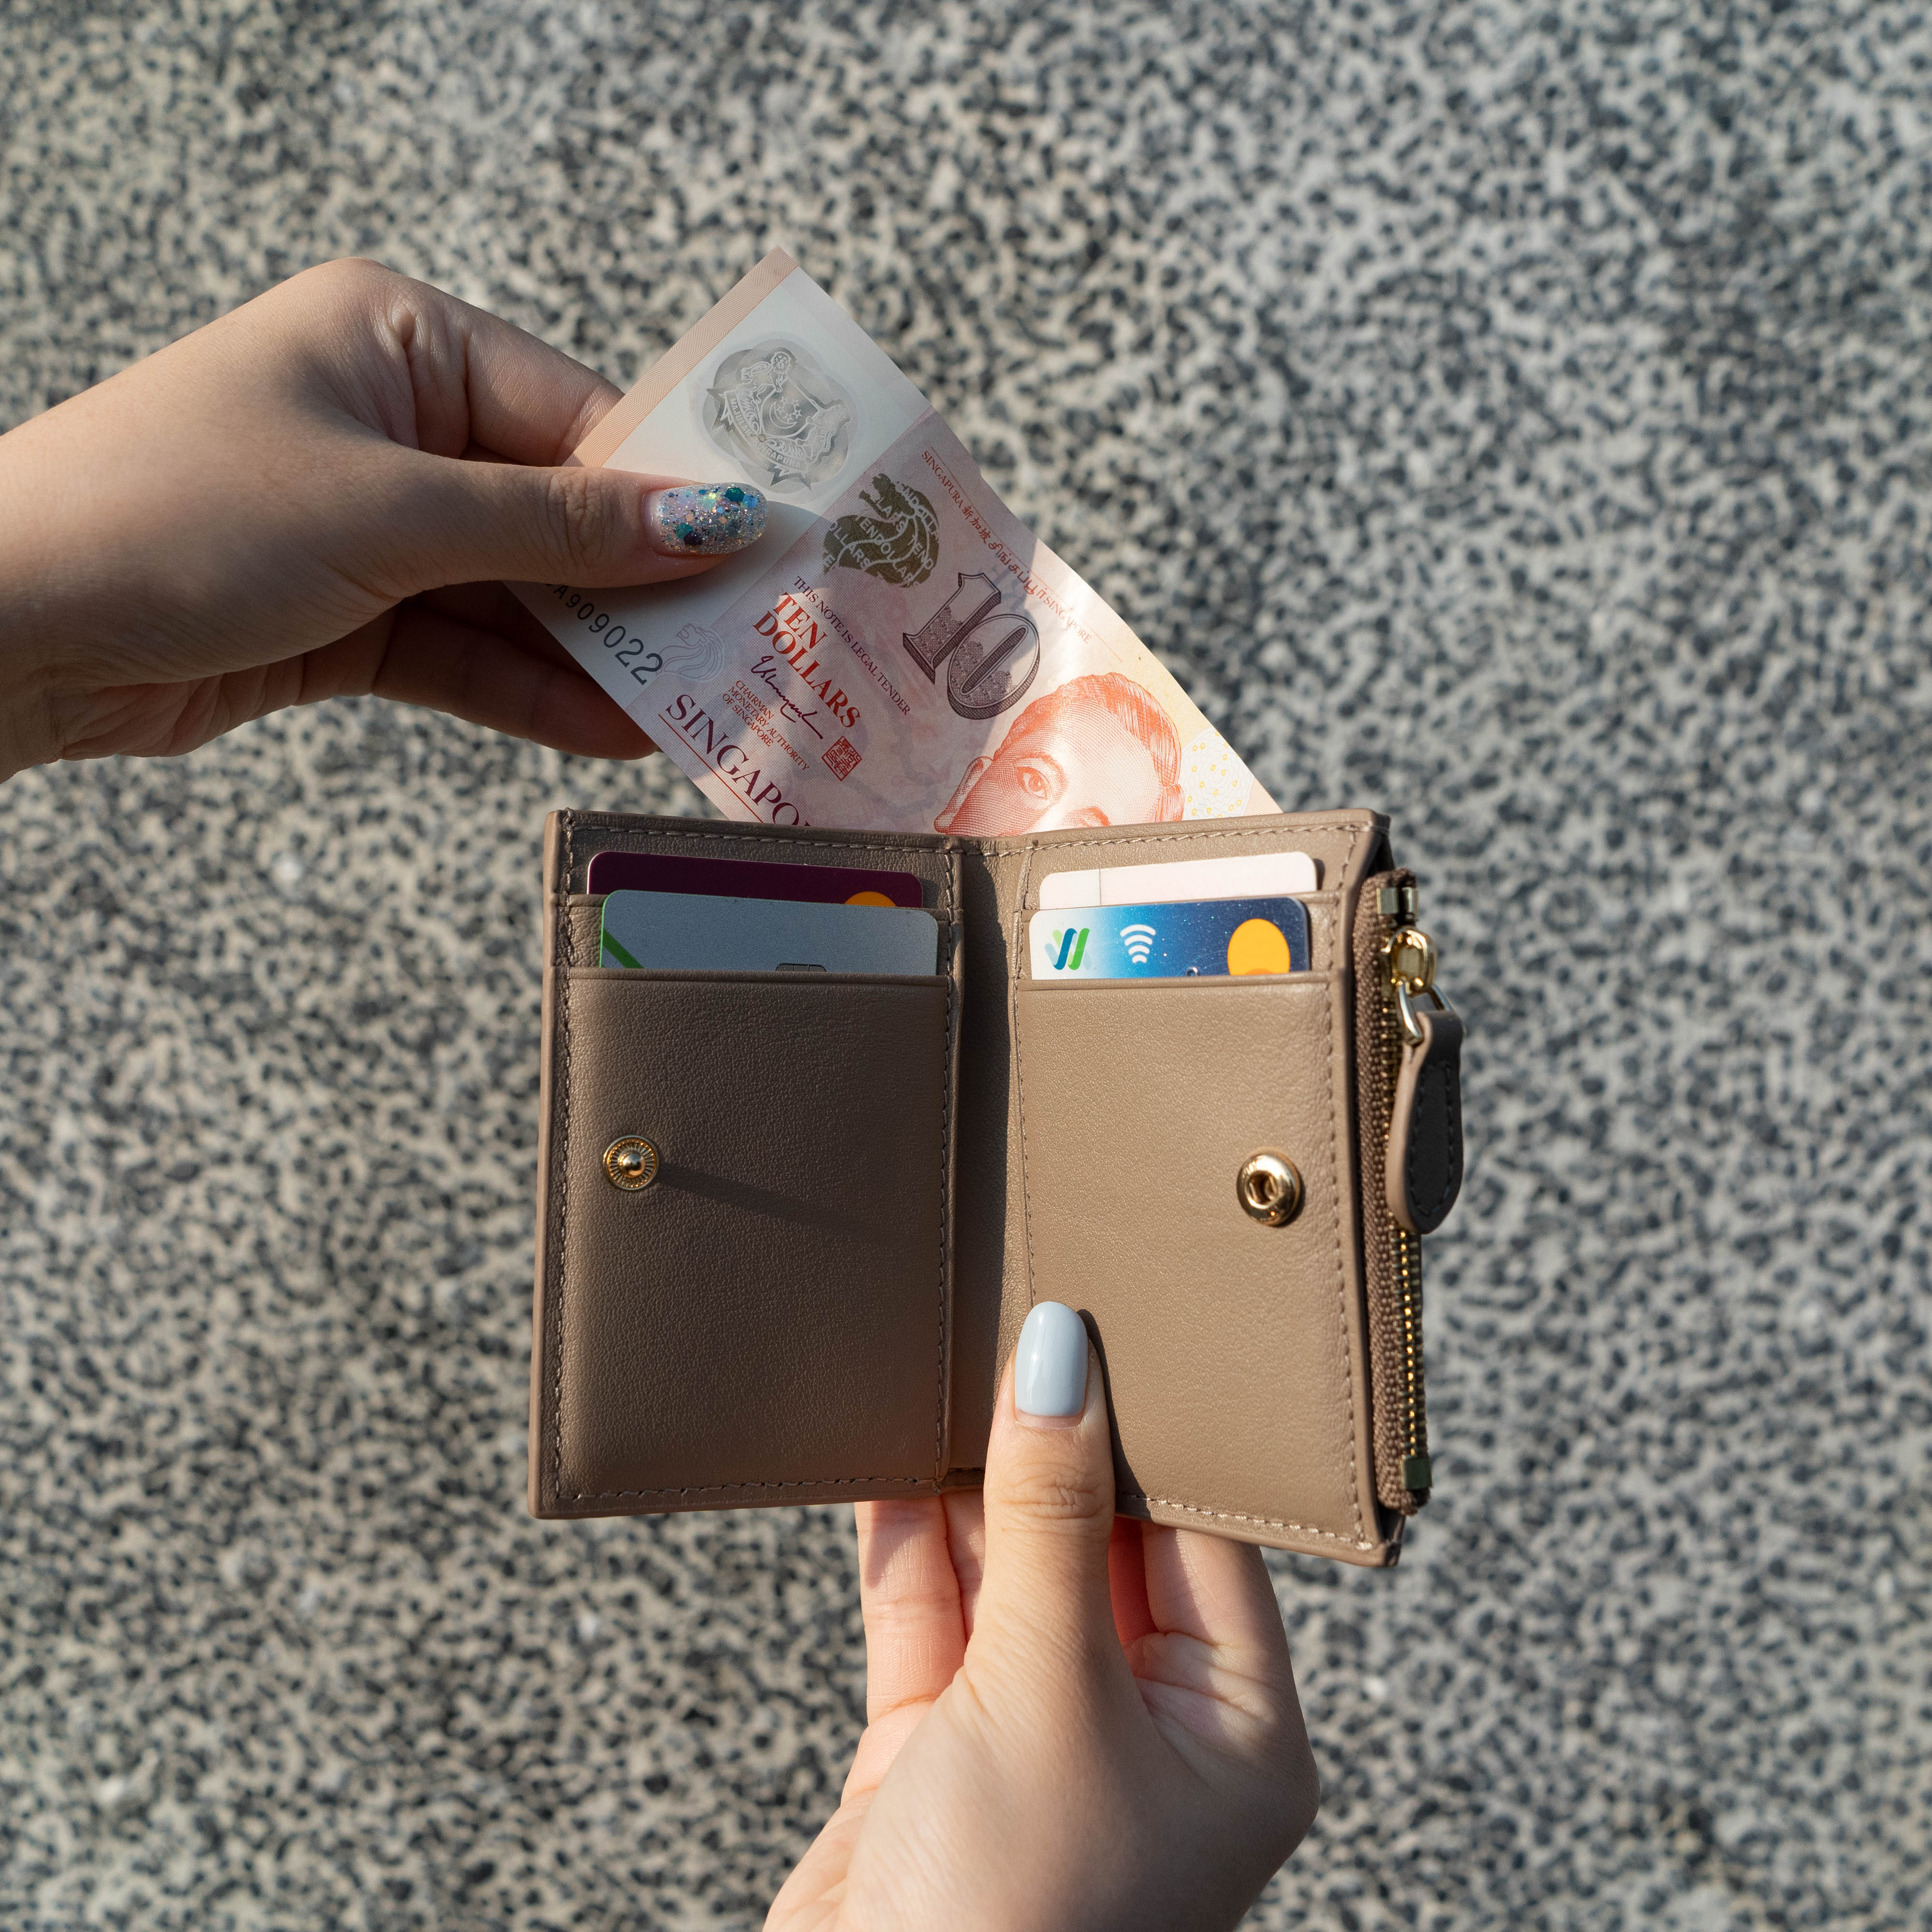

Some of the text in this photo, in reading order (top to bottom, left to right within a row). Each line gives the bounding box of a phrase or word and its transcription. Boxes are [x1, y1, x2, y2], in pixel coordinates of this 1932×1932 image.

[922, 451, 964, 509] SINGAPURA
[962, 505, 991, 544] 新加坡
[1043, 596, 1092, 644] SINGAPORE
[545, 583, 663, 686] A909022
[753, 611, 861, 728] DOLLARS
[773, 592, 828, 649] TEN
[794, 576, 910, 715] THIS NOTE IS LEGAL TENDER
[902, 572, 1040, 720] 10
[722, 694, 774, 747] OF SINGAPORE
[728, 686, 769, 728] MONETARY
[767, 728, 810, 771] AUTHORITY
[736, 680, 774, 720] CHAIRMAN
[666, 694, 811, 826] SINGAPO
